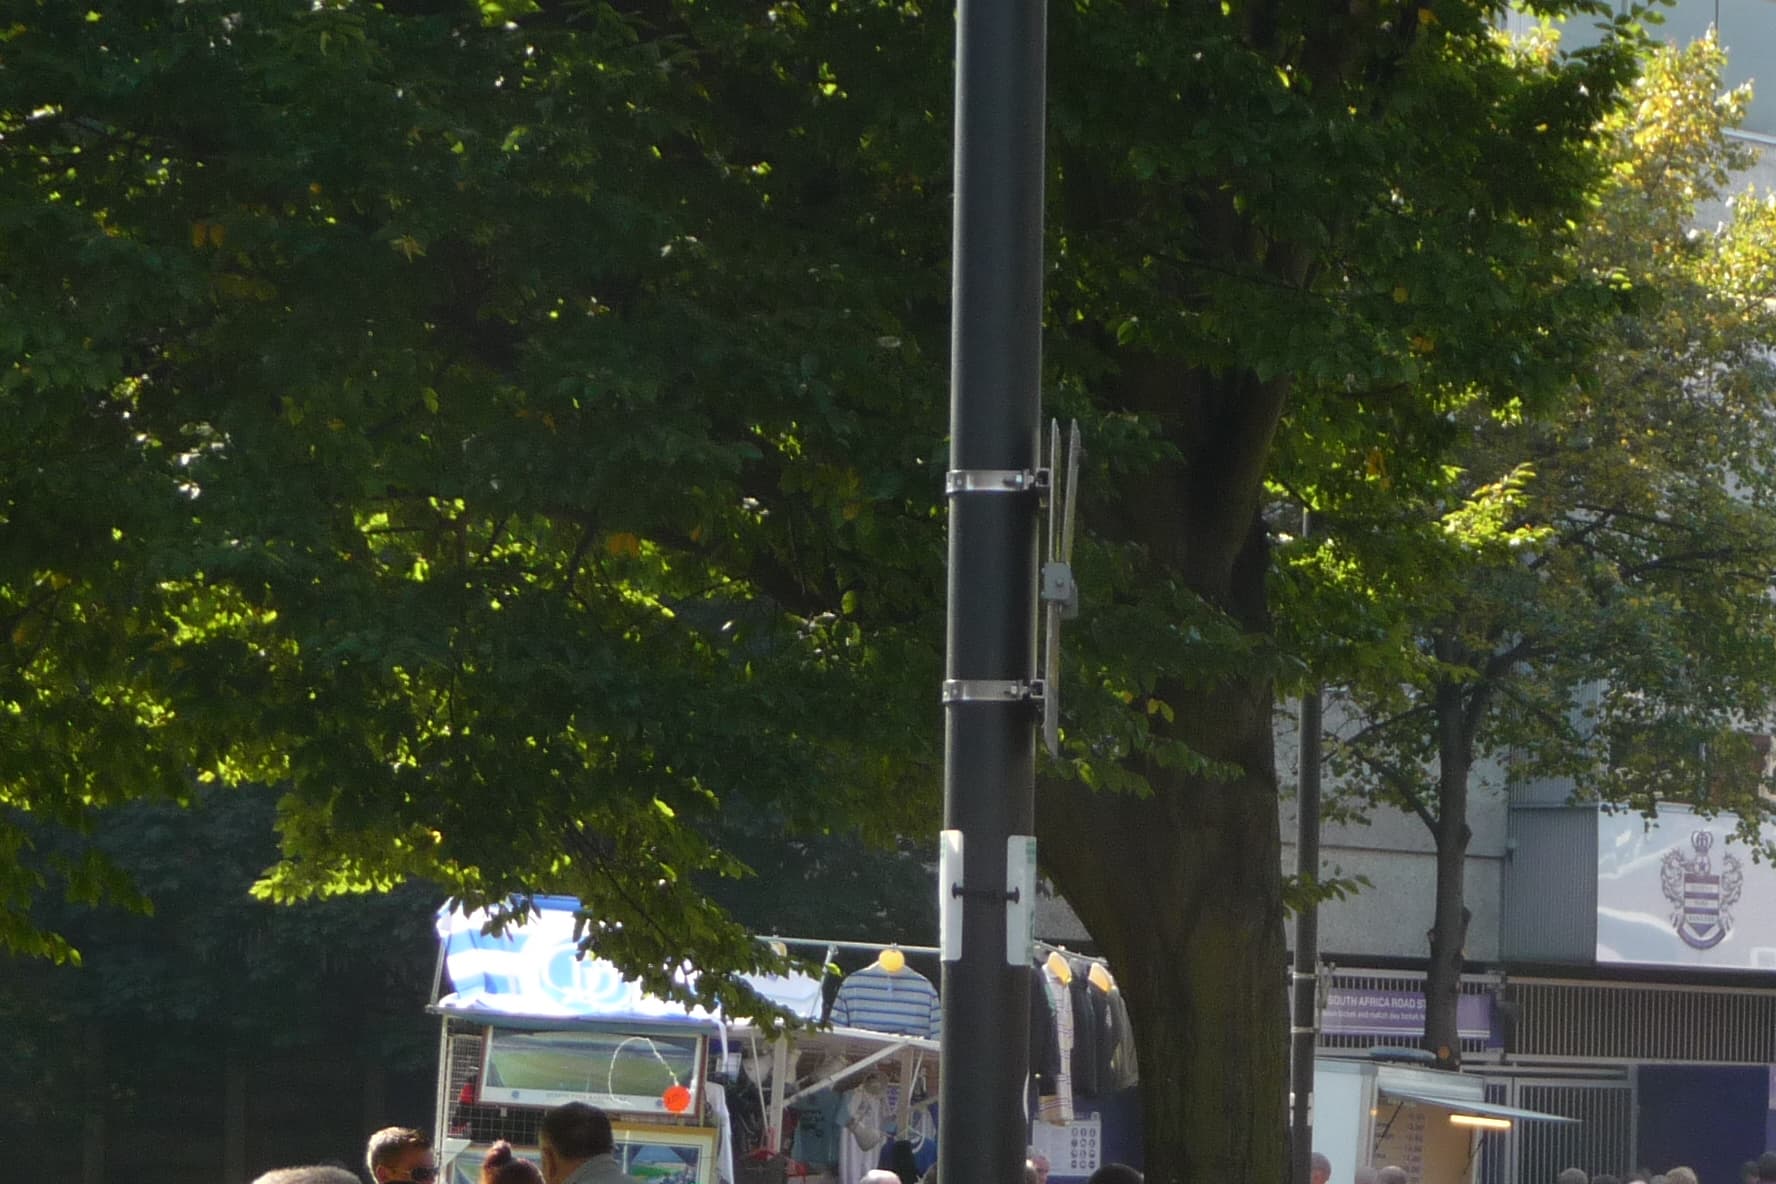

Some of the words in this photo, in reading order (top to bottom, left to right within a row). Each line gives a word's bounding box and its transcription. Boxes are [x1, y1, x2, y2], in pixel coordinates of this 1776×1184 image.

[1327, 995, 1357, 1006] SOUTH
[1358, 996, 1390, 1008] AFRICA
[1391, 997, 1415, 1009] ROAD
